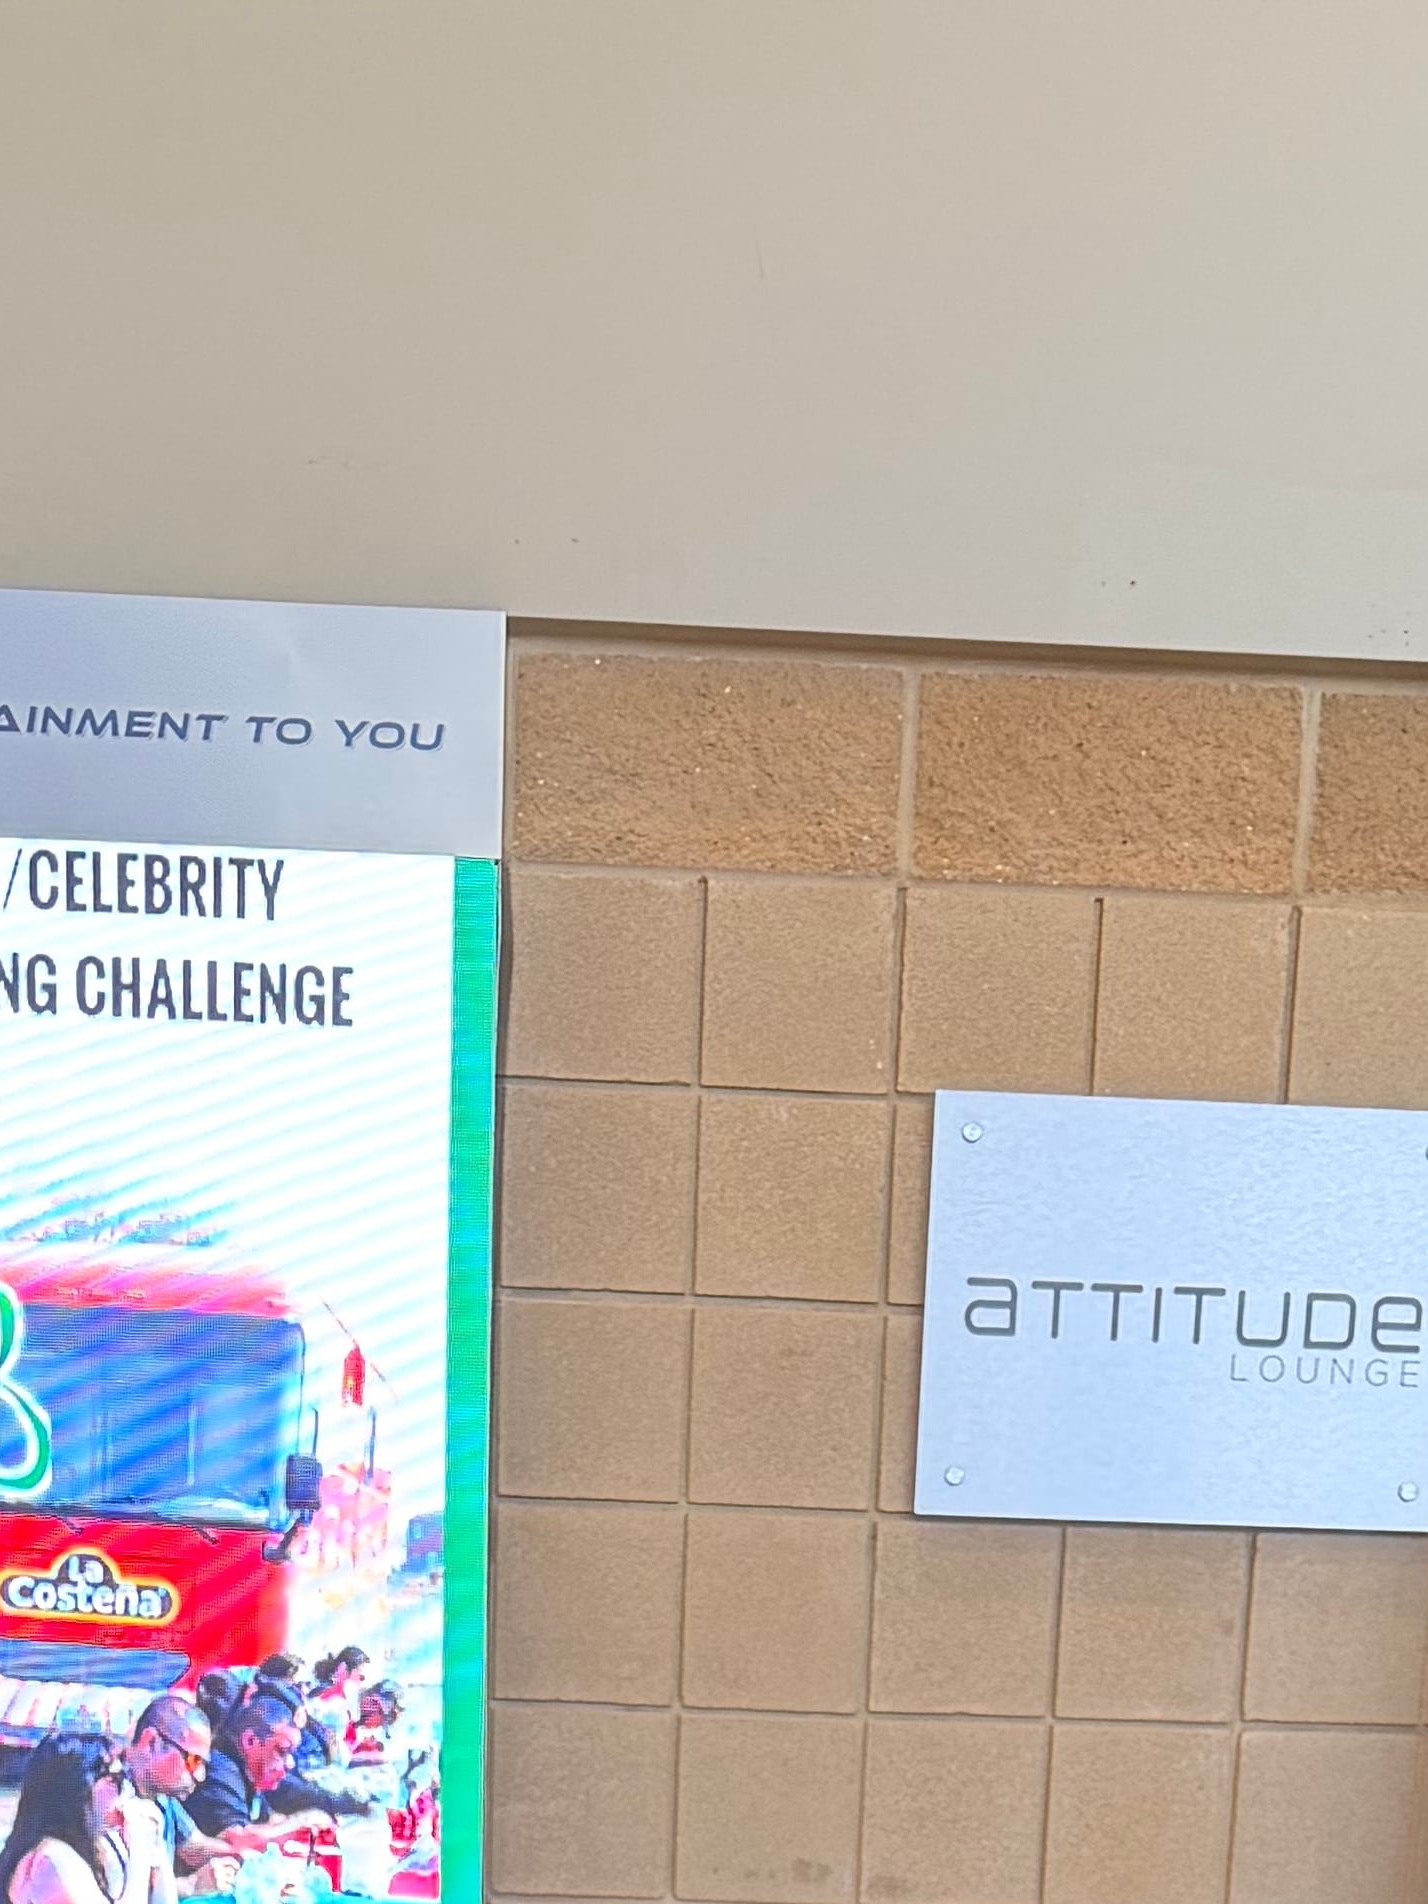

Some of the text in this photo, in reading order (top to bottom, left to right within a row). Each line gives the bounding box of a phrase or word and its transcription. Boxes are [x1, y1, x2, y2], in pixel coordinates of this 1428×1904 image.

[246, 716, 312, 745] TO
[335, 719, 445, 751] YOU
[76, 956, 354, 1027] CHALLENGE
[1229, 1353, 1422, 1388] LOUNGE
